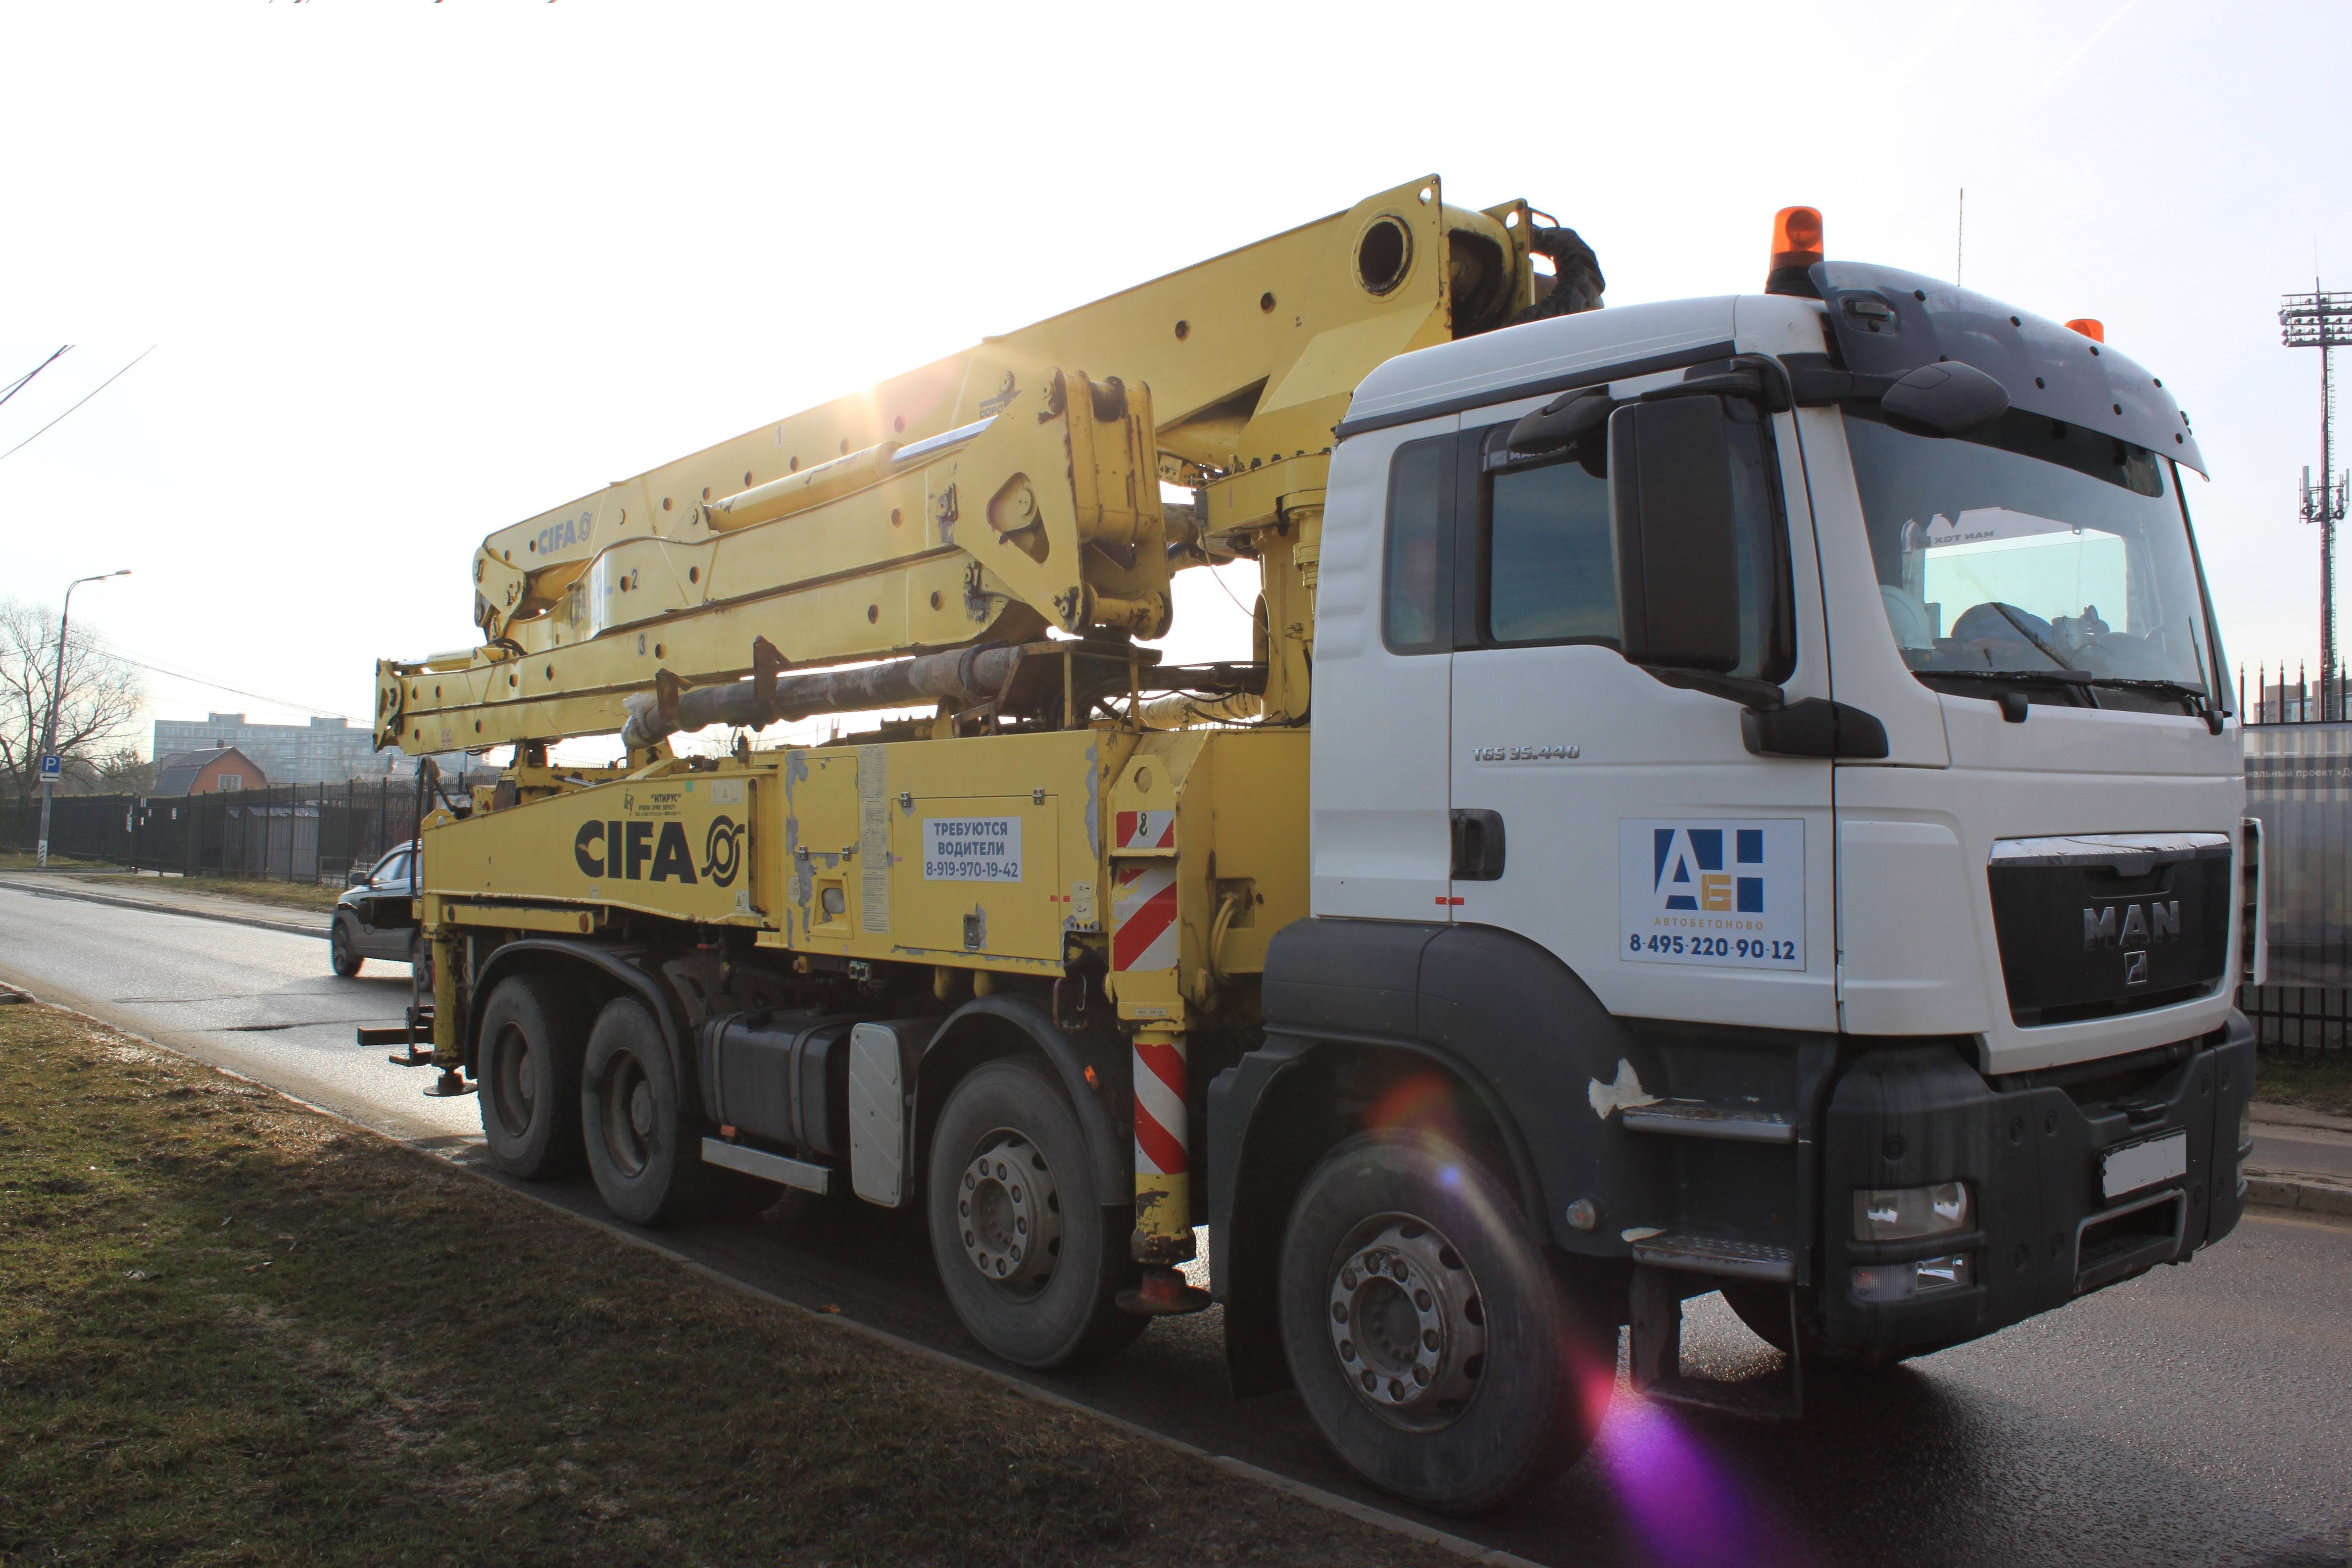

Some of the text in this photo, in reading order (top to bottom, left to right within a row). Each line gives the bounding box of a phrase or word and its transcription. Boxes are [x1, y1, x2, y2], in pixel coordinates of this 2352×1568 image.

[538, 520, 577, 555] CIFA
[632, 569, 637, 589] 2
[639, 635, 645, 654] 3
[1472, 744, 1580, 761] TGS 35.440
[46, 757, 56, 771] P
[934, 821, 1008, 836] ТРЕБУЮТСЯ
[575, 820, 698, 884] CIFA
[938, 841, 1005, 857] ВОДИТЕЛИ
[926, 862, 1019, 878] 8-919-970-19-42
[1655, 917, 1764, 931] АВТОБЕТОНОВО
[2083, 901, 2180, 950] MAN
[1629, 933, 1795, 960] 8-495-220-90-12
